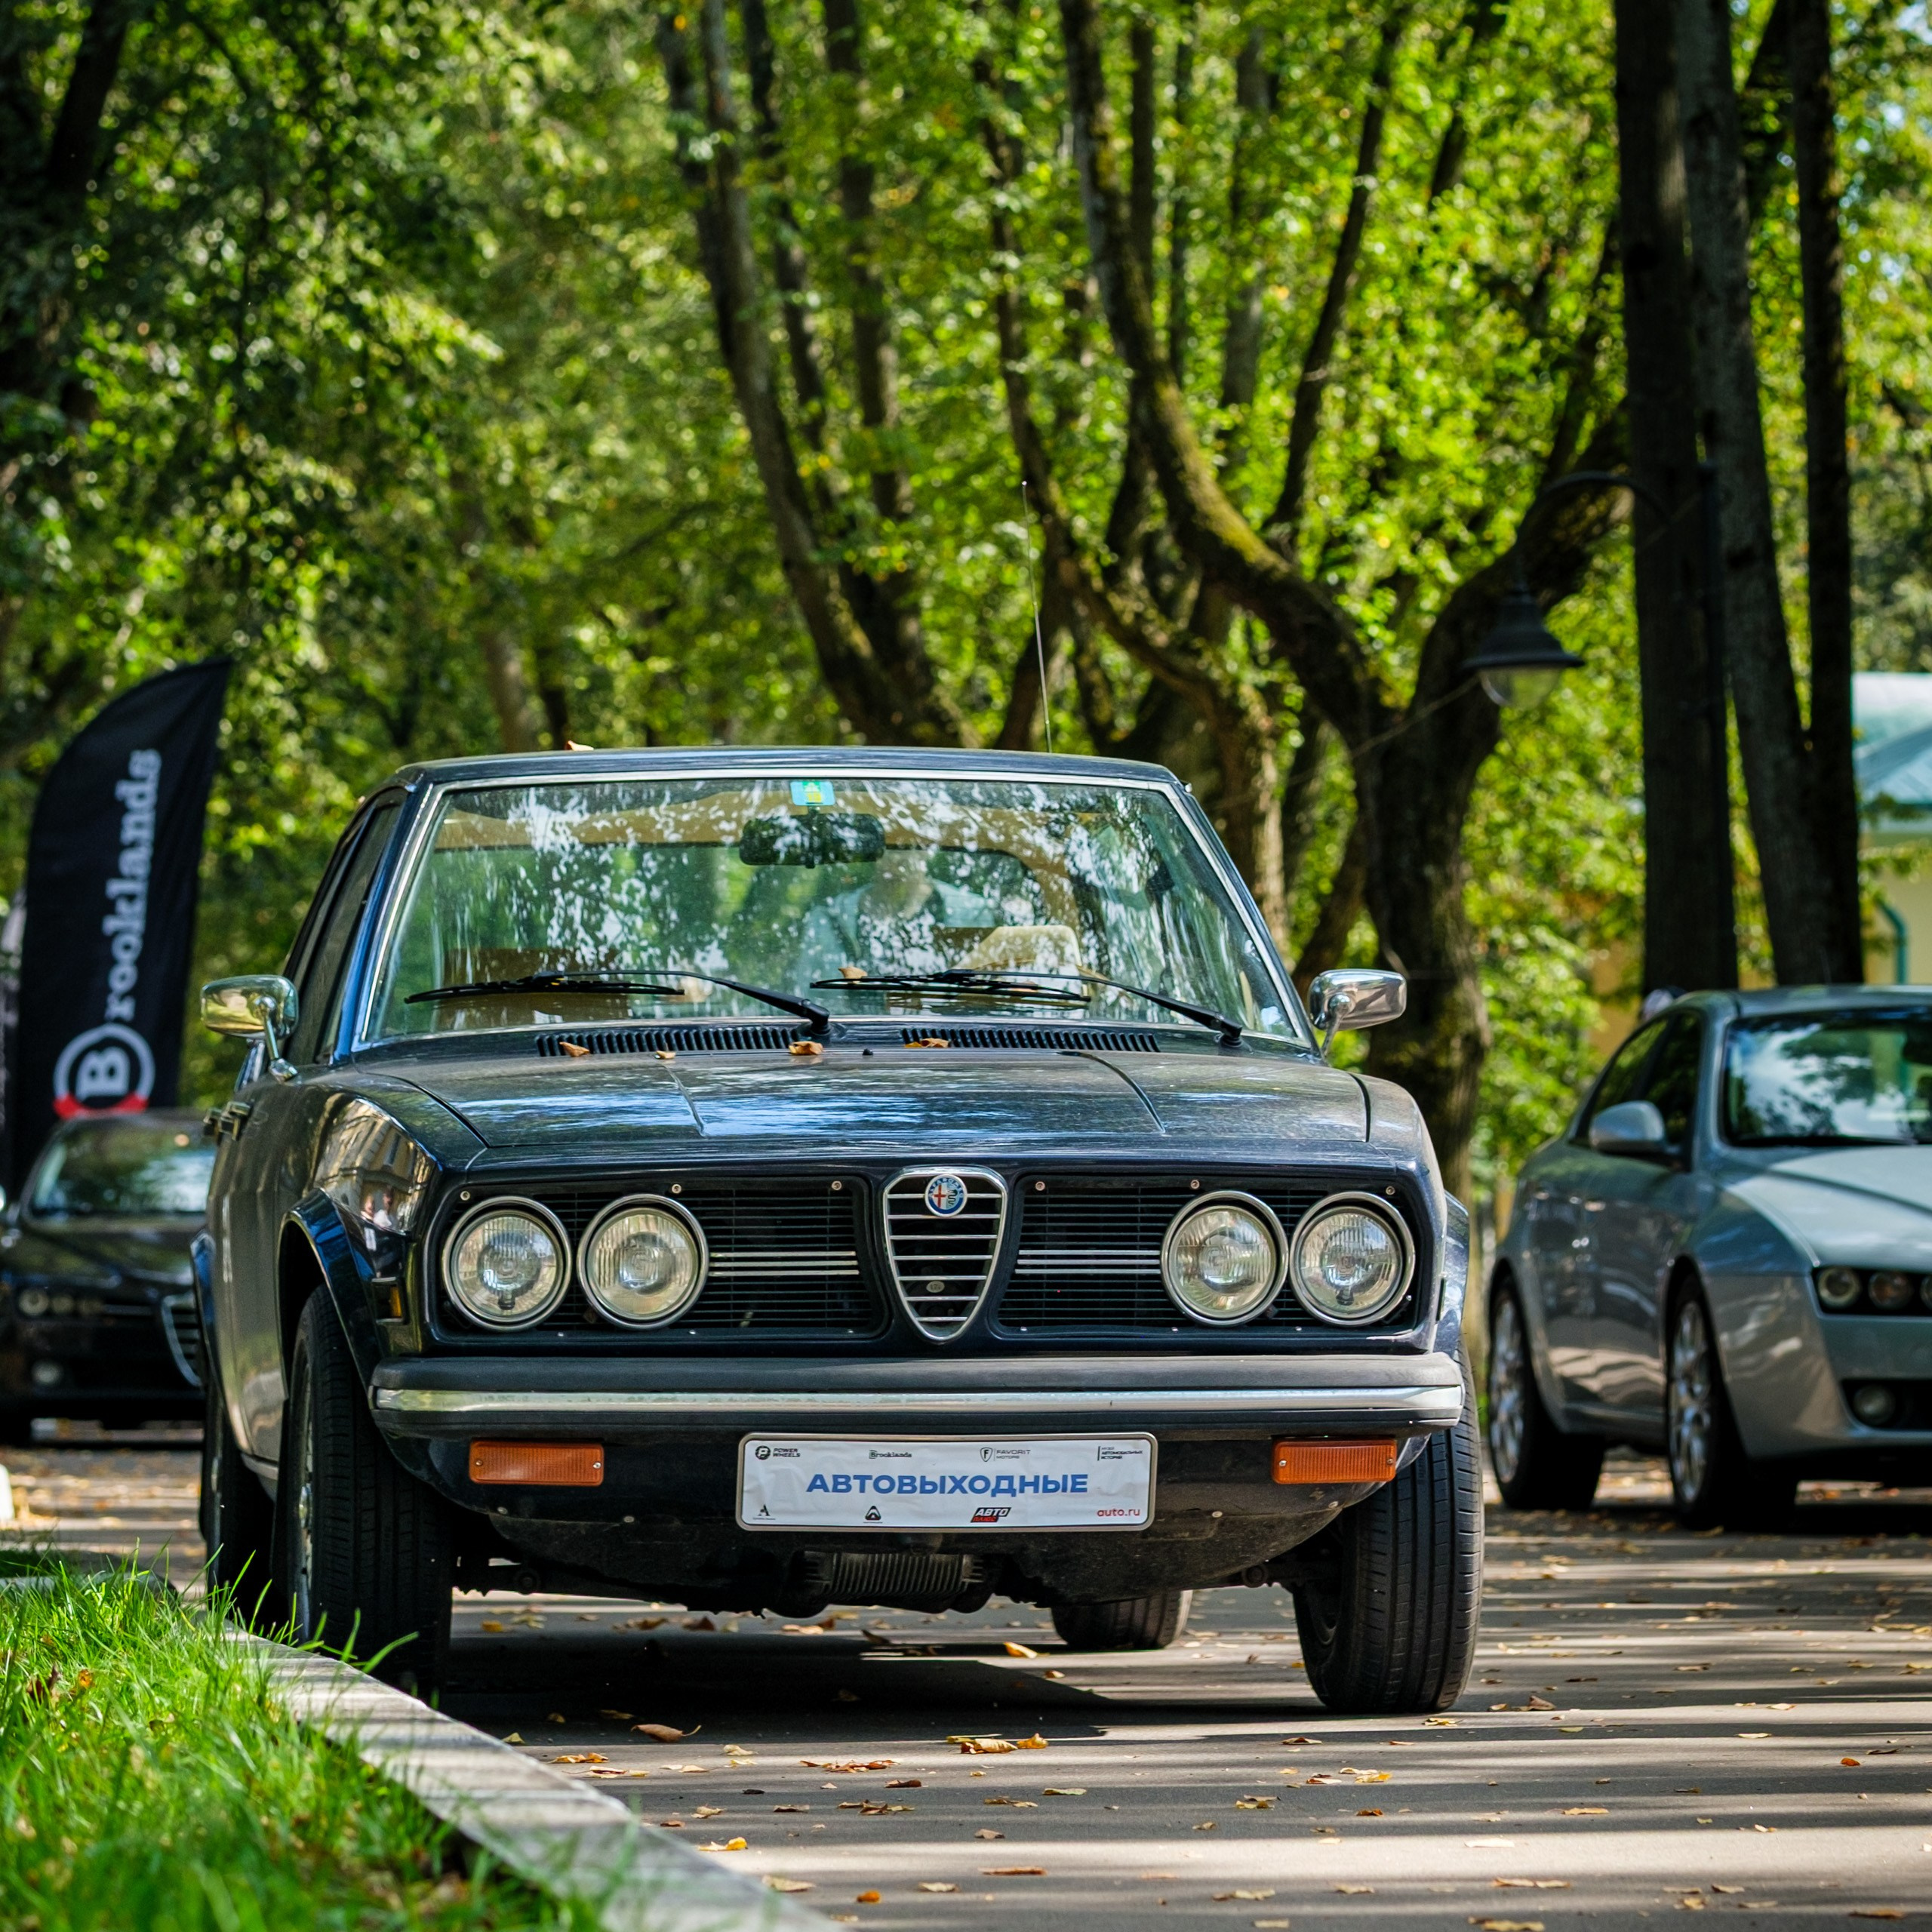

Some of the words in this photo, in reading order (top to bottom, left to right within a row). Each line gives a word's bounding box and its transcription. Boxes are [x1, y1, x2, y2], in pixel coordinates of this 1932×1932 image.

[77, 749, 162, 1102] Brooklands
[806, 1473, 1088, 1497] АВТОВЫХОДНЫЕ
[974, 1508, 1009, 1516] АВТО
[1097, 1507, 1140, 1517] auto.ru
